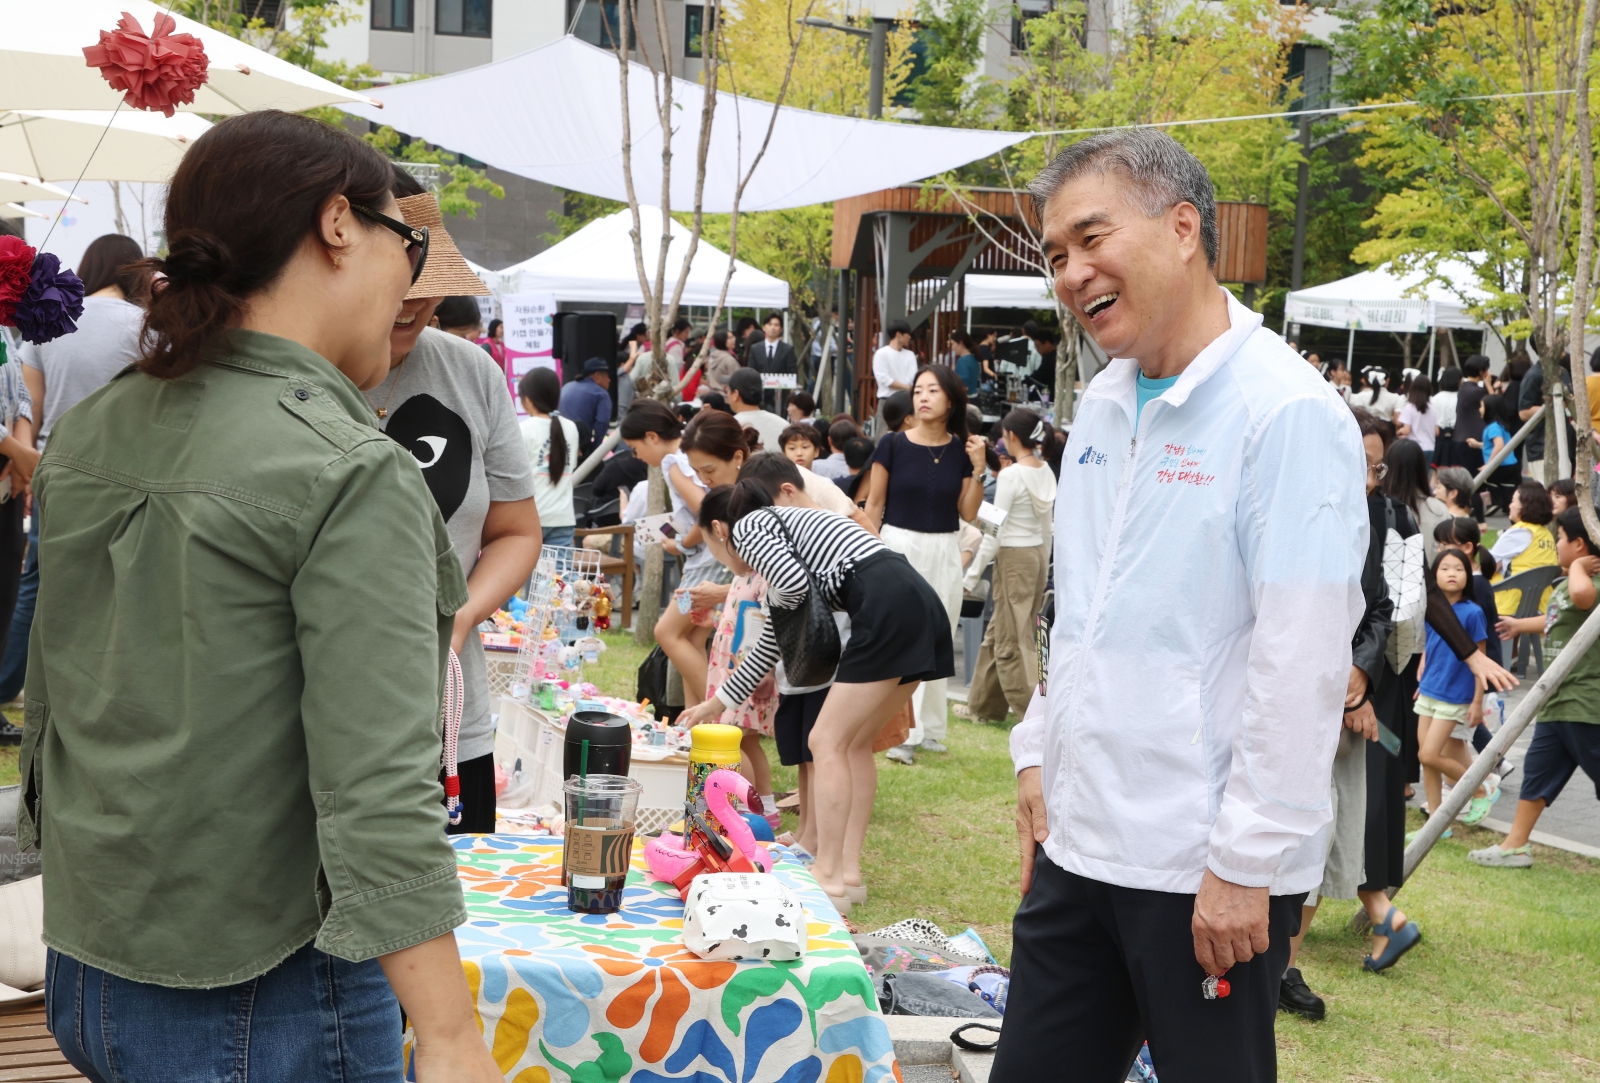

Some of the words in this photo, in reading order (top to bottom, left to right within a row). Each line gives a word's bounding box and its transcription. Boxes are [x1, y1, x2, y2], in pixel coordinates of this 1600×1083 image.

[514, 305, 545, 313] 자원순환
[519, 317, 542, 325] 병뚜껑
[528, 328, 553, 338] 만들기
[1090, 450, 1108, 466] 강남구
[1155, 468, 1176, 484] 강남
